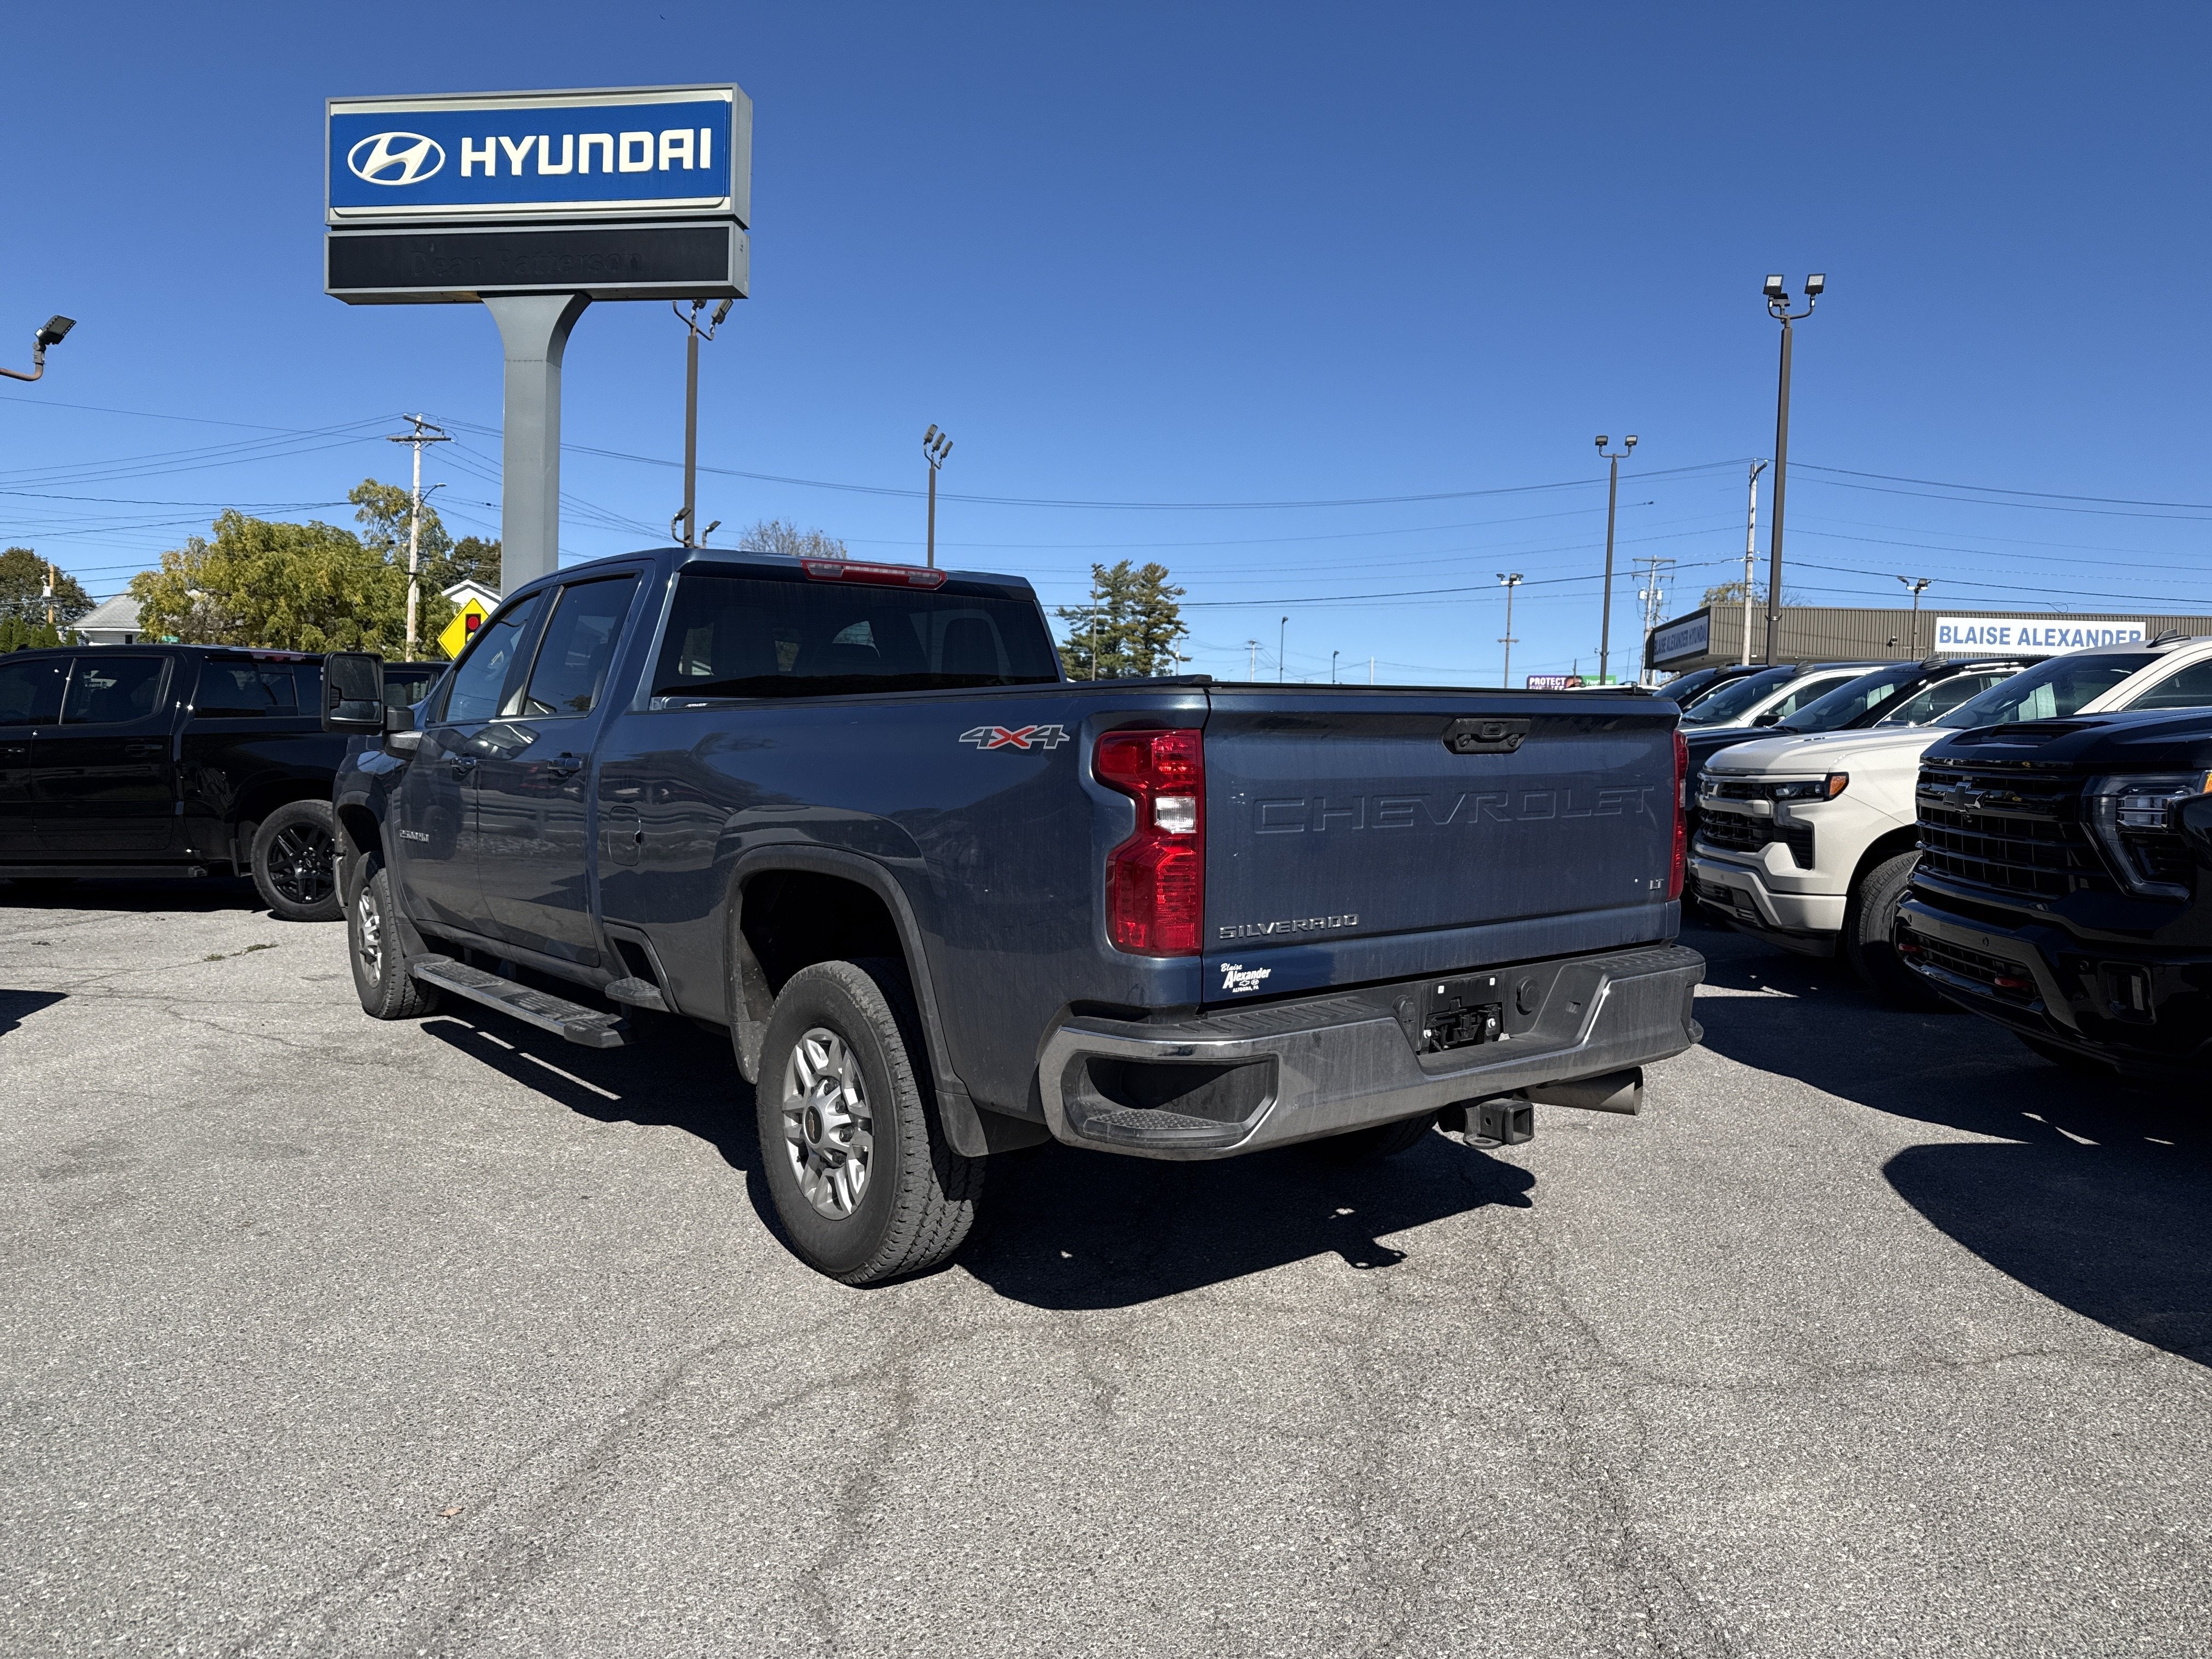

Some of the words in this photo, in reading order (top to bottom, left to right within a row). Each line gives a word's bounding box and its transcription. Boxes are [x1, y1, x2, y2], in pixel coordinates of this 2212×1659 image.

[461, 128, 711, 177] HYUNDAI
[1940, 625, 2010, 645] BLAISE
[1530, 677, 1566, 685] PROTECT
[1253, 785, 1654, 834] CHEVROLET
[1650, 878, 1664, 889] LT
[1219, 913, 1359, 939] SILVERADO
[1221, 963, 1242, 972] Blaise
[1222, 967, 1271, 989] Alexander
